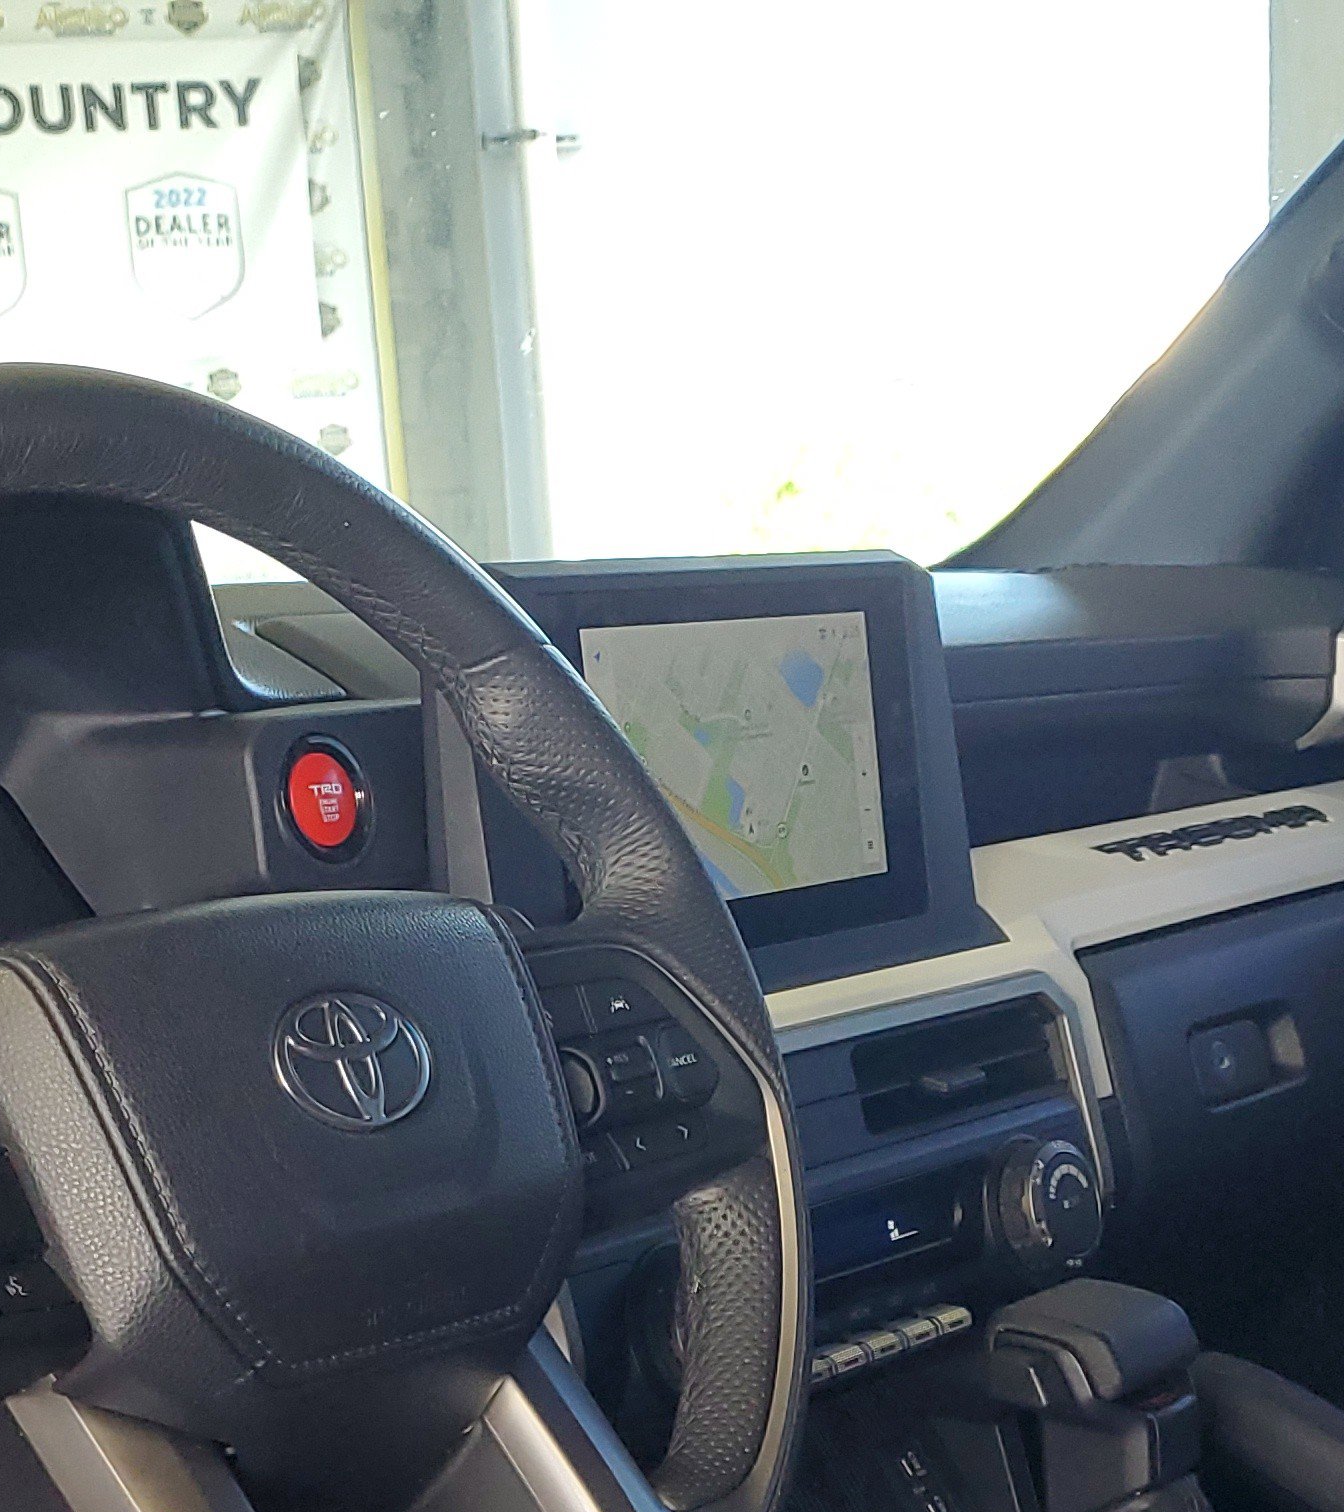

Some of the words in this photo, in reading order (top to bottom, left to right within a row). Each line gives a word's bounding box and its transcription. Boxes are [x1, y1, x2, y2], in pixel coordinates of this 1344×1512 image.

[153, 186, 208, 209] 2022
[135, 213, 232, 238] DEALER
[308, 783, 343, 797] TRD
